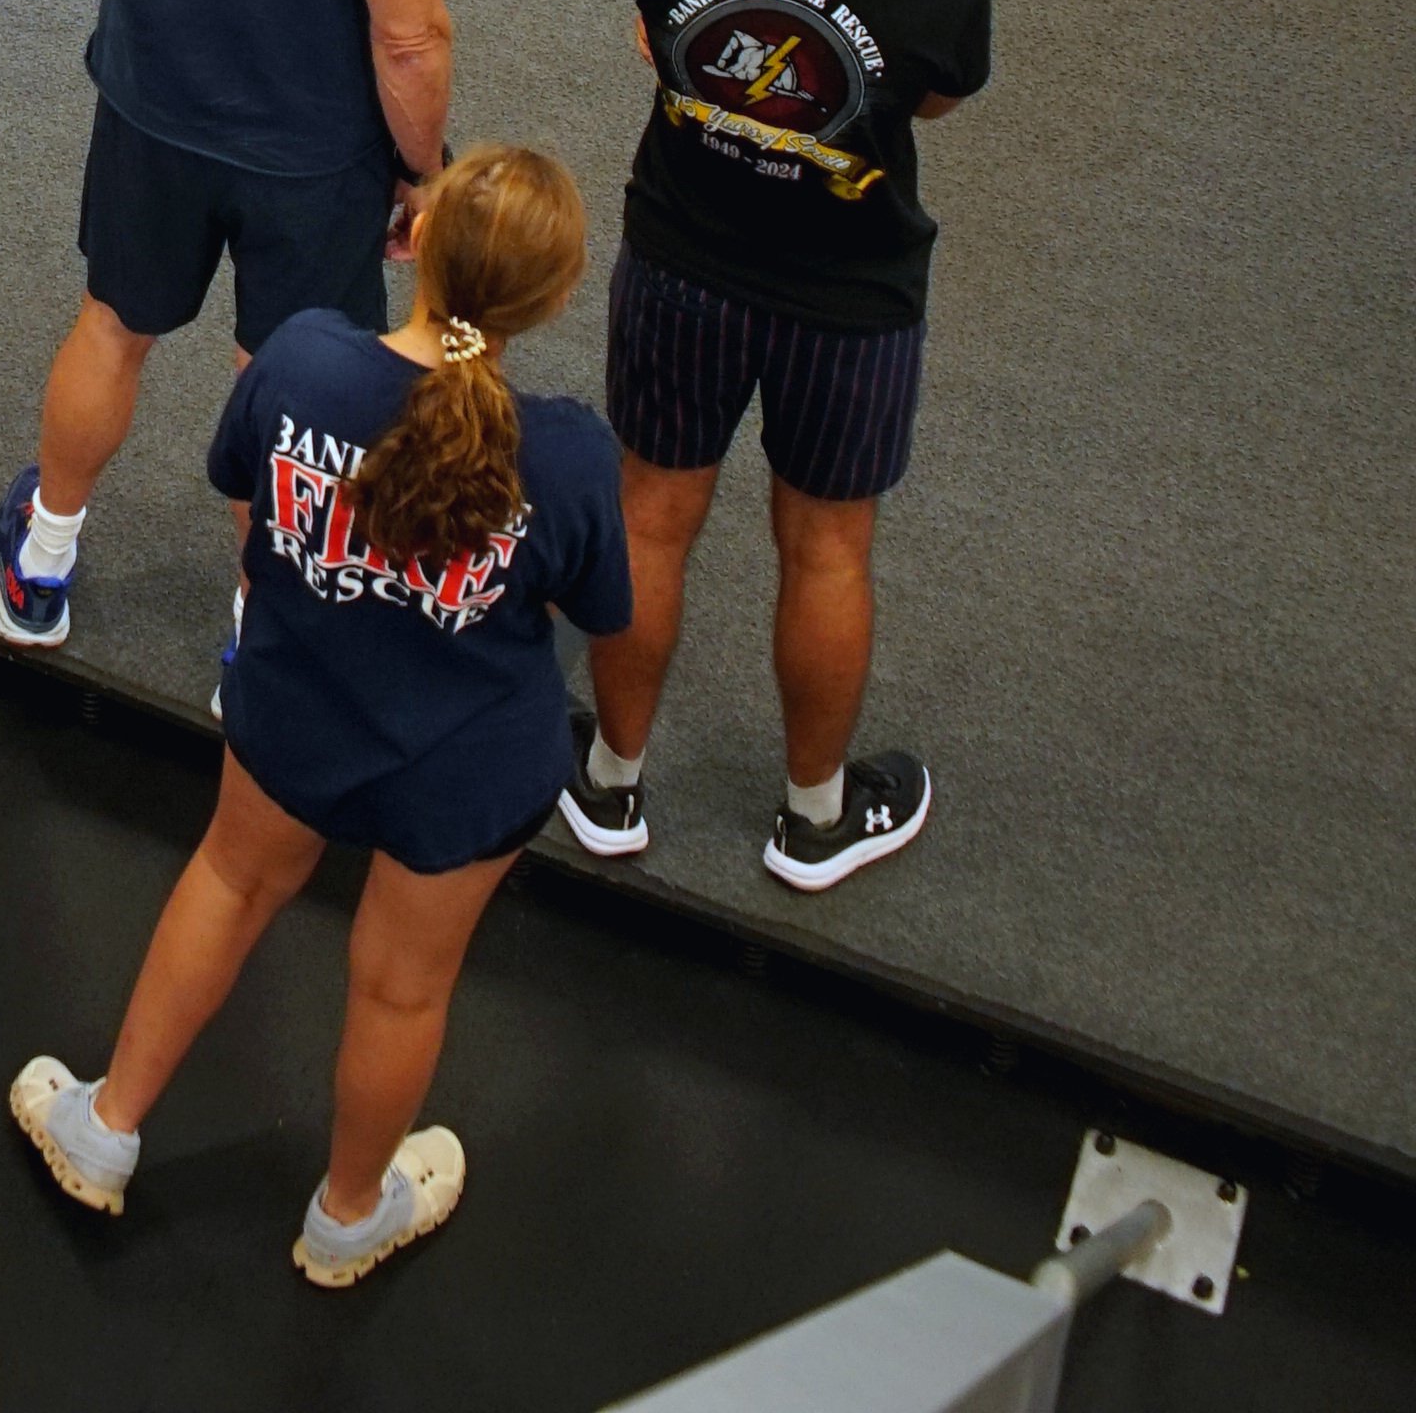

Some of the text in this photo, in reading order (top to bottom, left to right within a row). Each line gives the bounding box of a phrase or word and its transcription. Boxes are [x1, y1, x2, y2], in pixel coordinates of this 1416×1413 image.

[830, 3, 885, 72] RESCUE
[695, 98, 761, 136] Years
[700, 131, 741, 159] 1949
[754, 158, 802, 181] 2024
